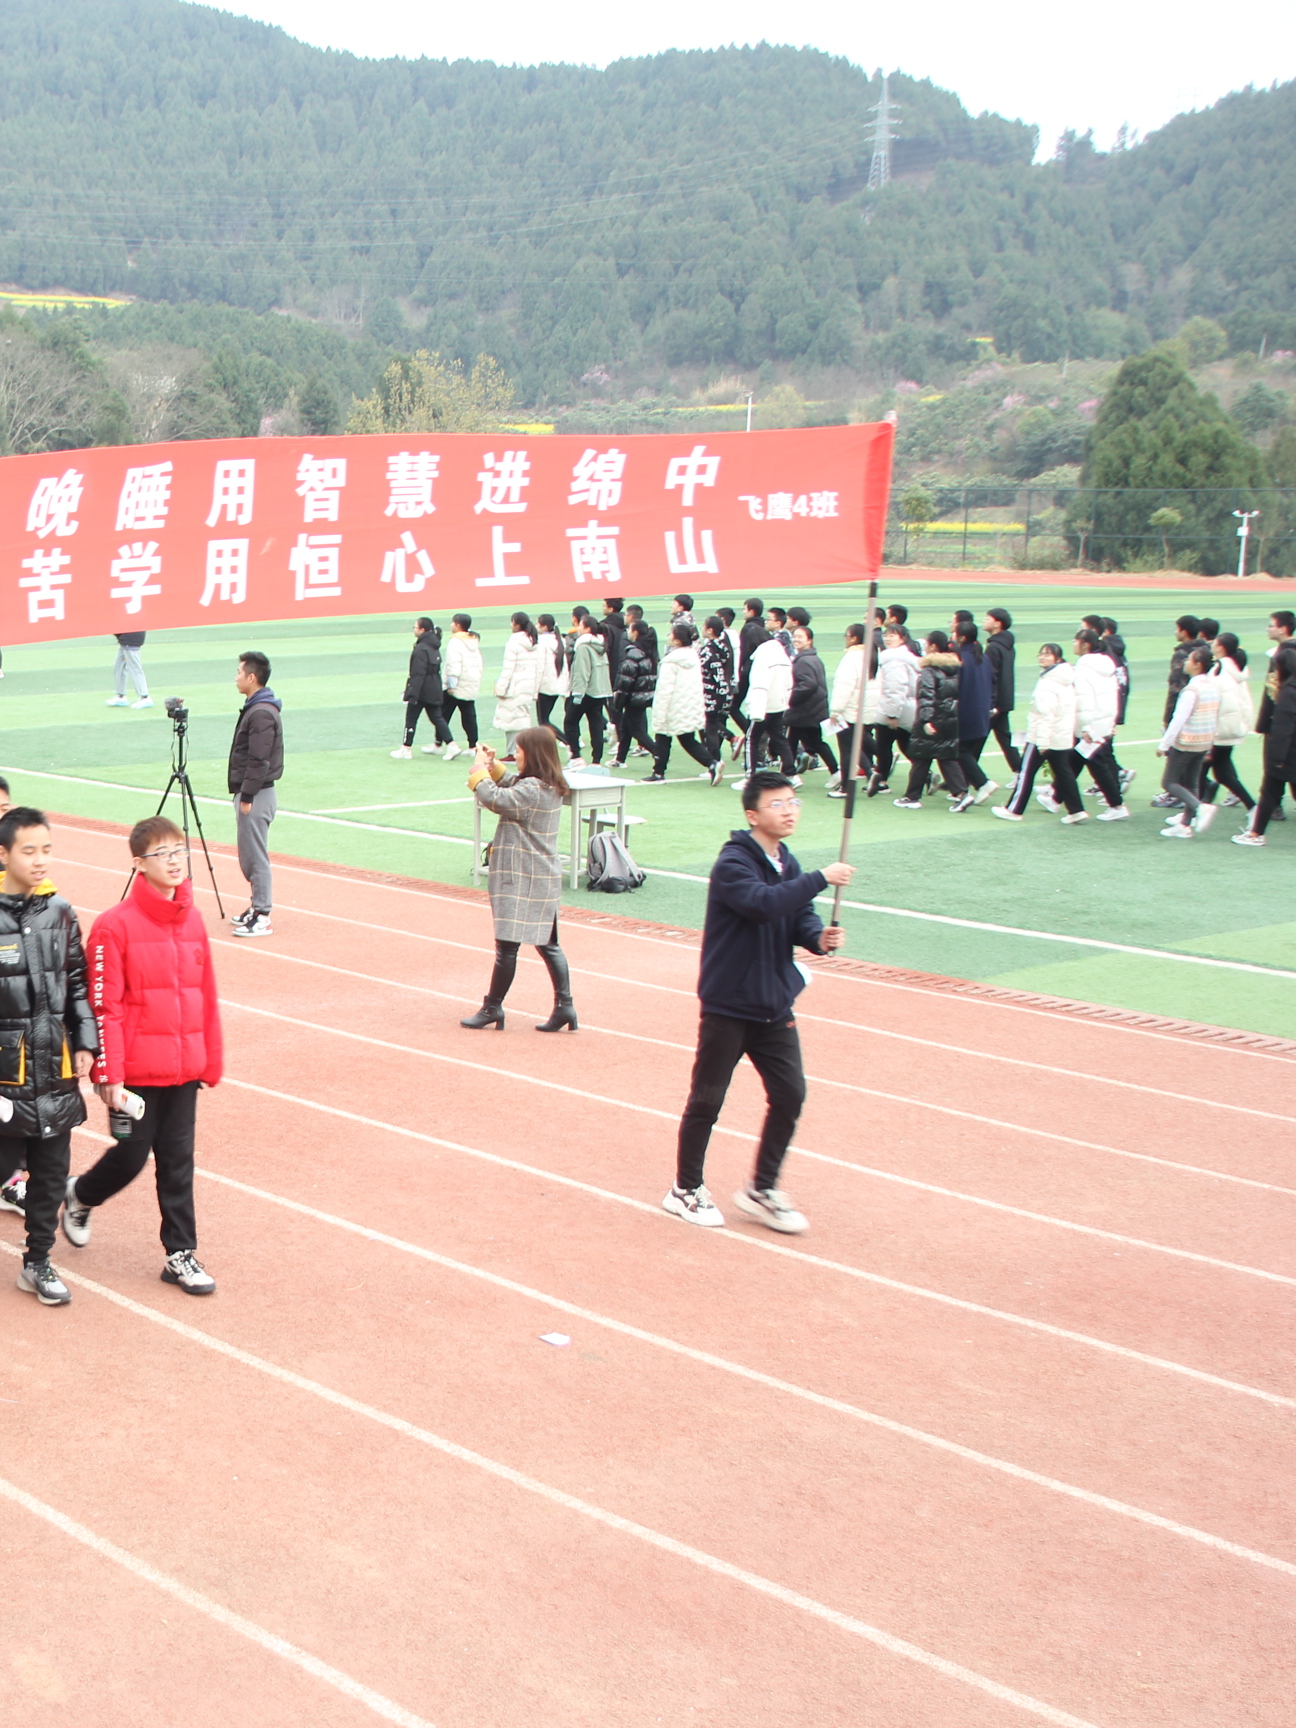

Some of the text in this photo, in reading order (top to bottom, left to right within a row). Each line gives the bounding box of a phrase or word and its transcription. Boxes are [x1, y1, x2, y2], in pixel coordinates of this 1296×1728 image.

[737, 491, 840, 521] 飞鹰4班
[94, 945, 105, 972] NEW
[94, 975, 105, 1007] YORK
